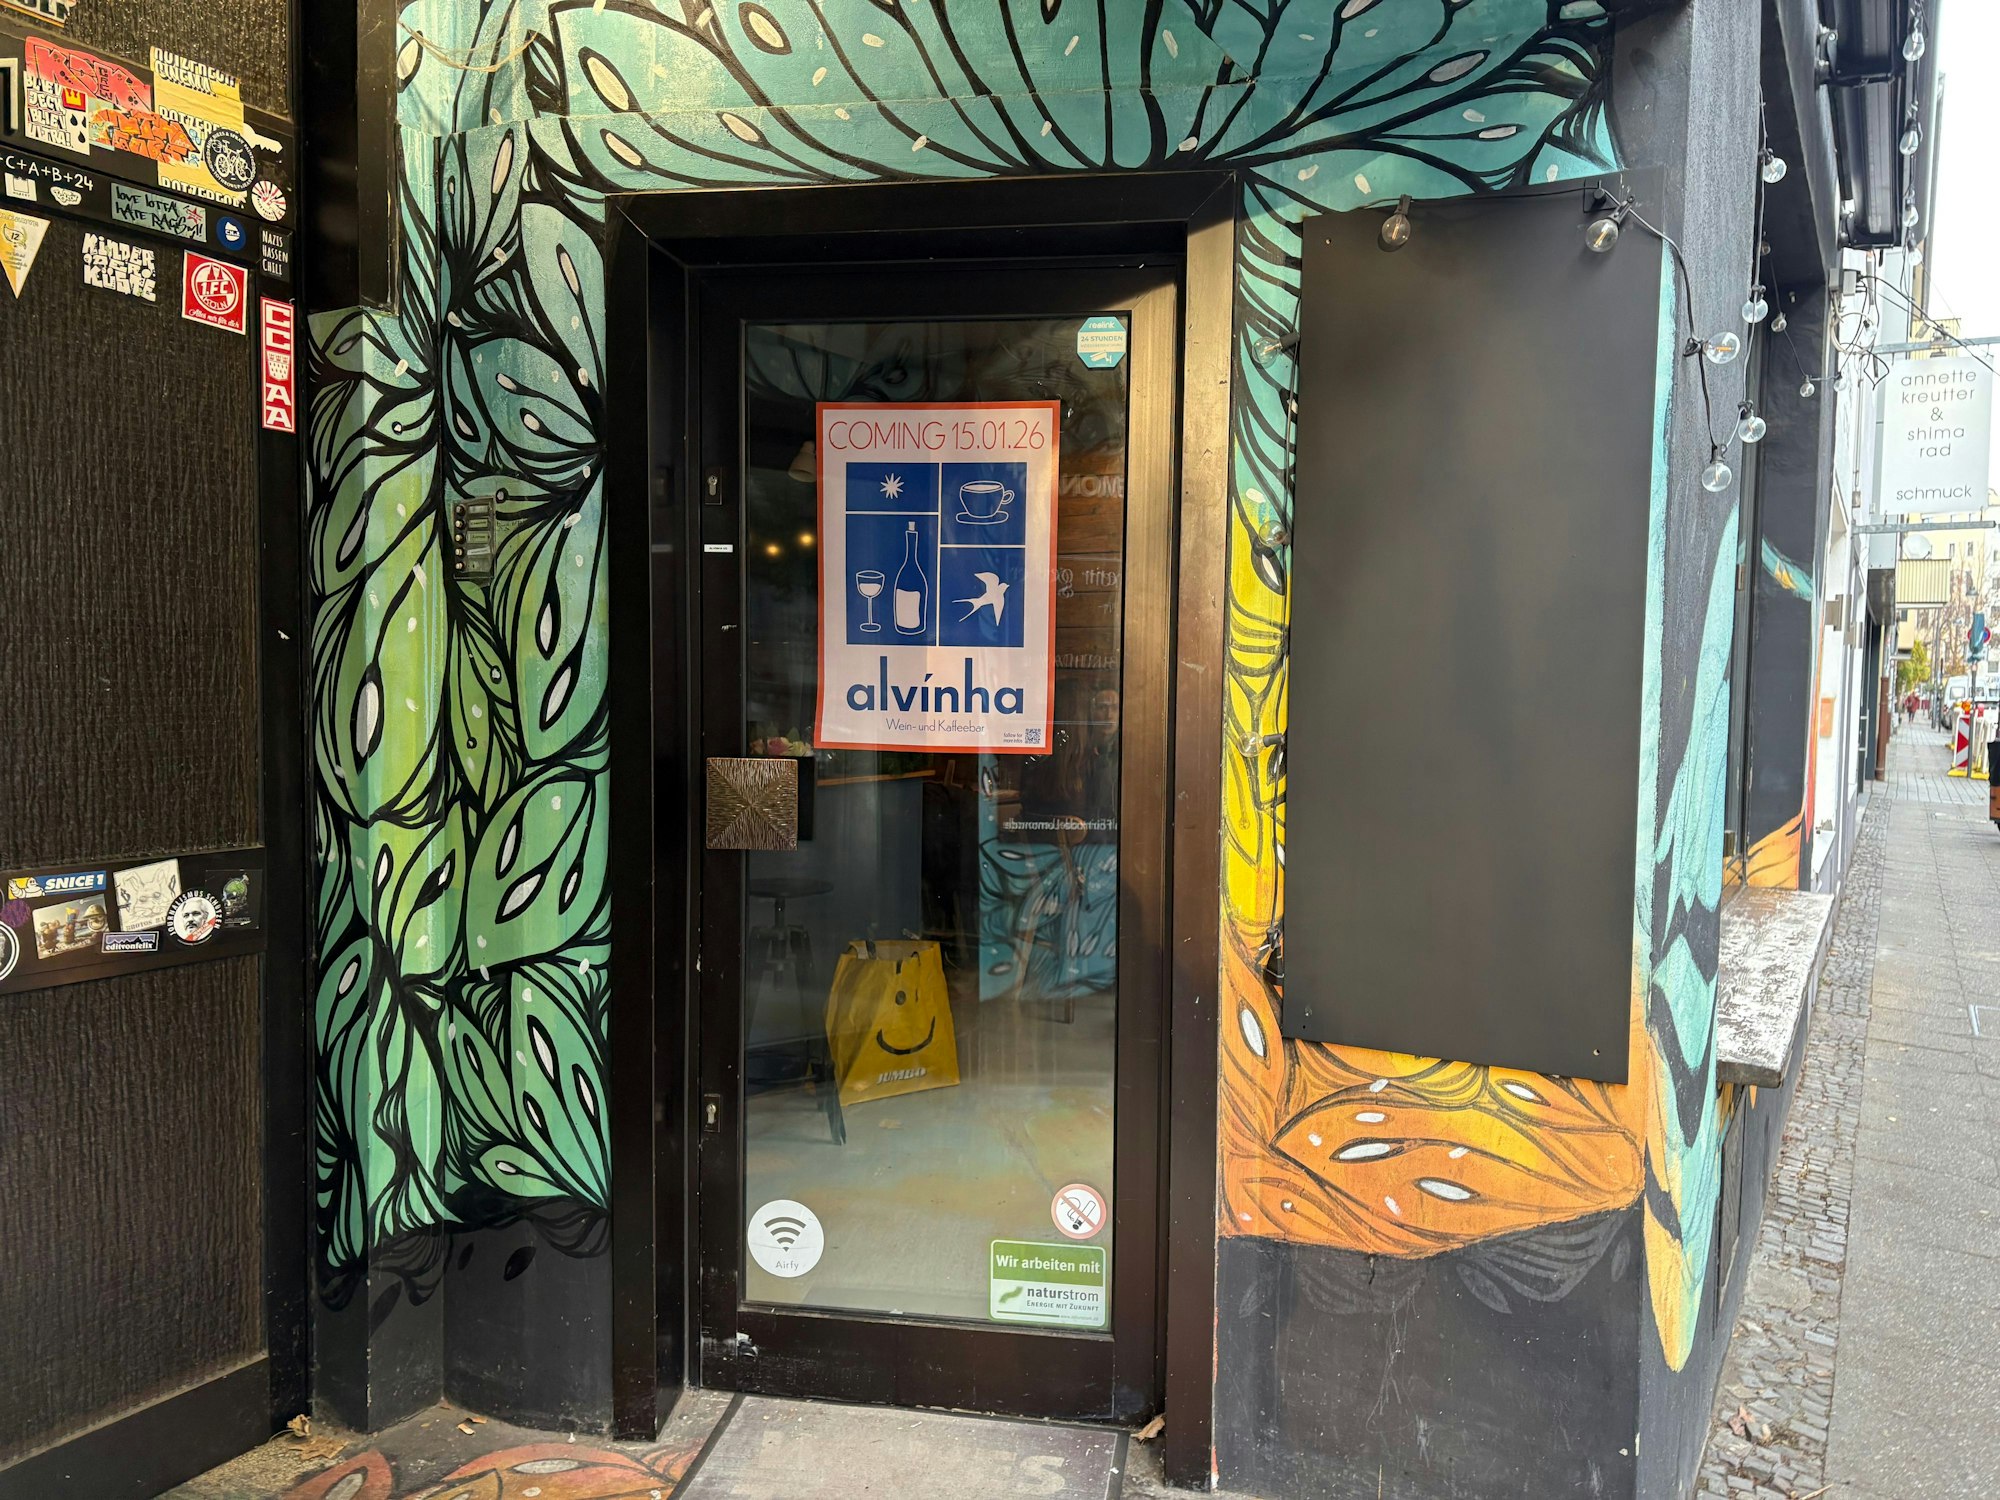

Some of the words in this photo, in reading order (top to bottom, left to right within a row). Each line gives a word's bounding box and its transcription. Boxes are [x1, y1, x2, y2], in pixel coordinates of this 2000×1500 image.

[262, 230, 283, 248] NAZIS
[262, 245, 289, 263] HASSEN
[262, 261, 283, 276] CHILI
[1900, 370, 1977, 387] annette
[1902, 388, 1975, 404] kreutter
[1930, 407, 1944, 421] &
[828, 420, 947, 451] COMING
[951, 420, 1045, 450] 15.01.26
[1920, 443, 1952, 458] rad
[1896, 484, 1972, 501] schmuck
[846, 655, 1024, 714] alvínha
[918, 721, 936, 732] und
[938, 720, 985, 733] Kaffeebar
[44, 875, 94, 890] SNICE
[97, 874, 104, 885] 1
[877, 1067, 928, 1085] JUMBO
[775, 1259, 799, 1271] Airfy
[996, 1254, 1018, 1268] Wir
[1022, 1258, 1075, 1271] arbeiten
[1079, 1261, 1101, 1274] mit
[1027, 1287, 1099, 1302] naturstrom
[1027, 1300, 1054, 1309] ENERGIE
[1069, 1303, 1099, 1311] ZUKUNFT
